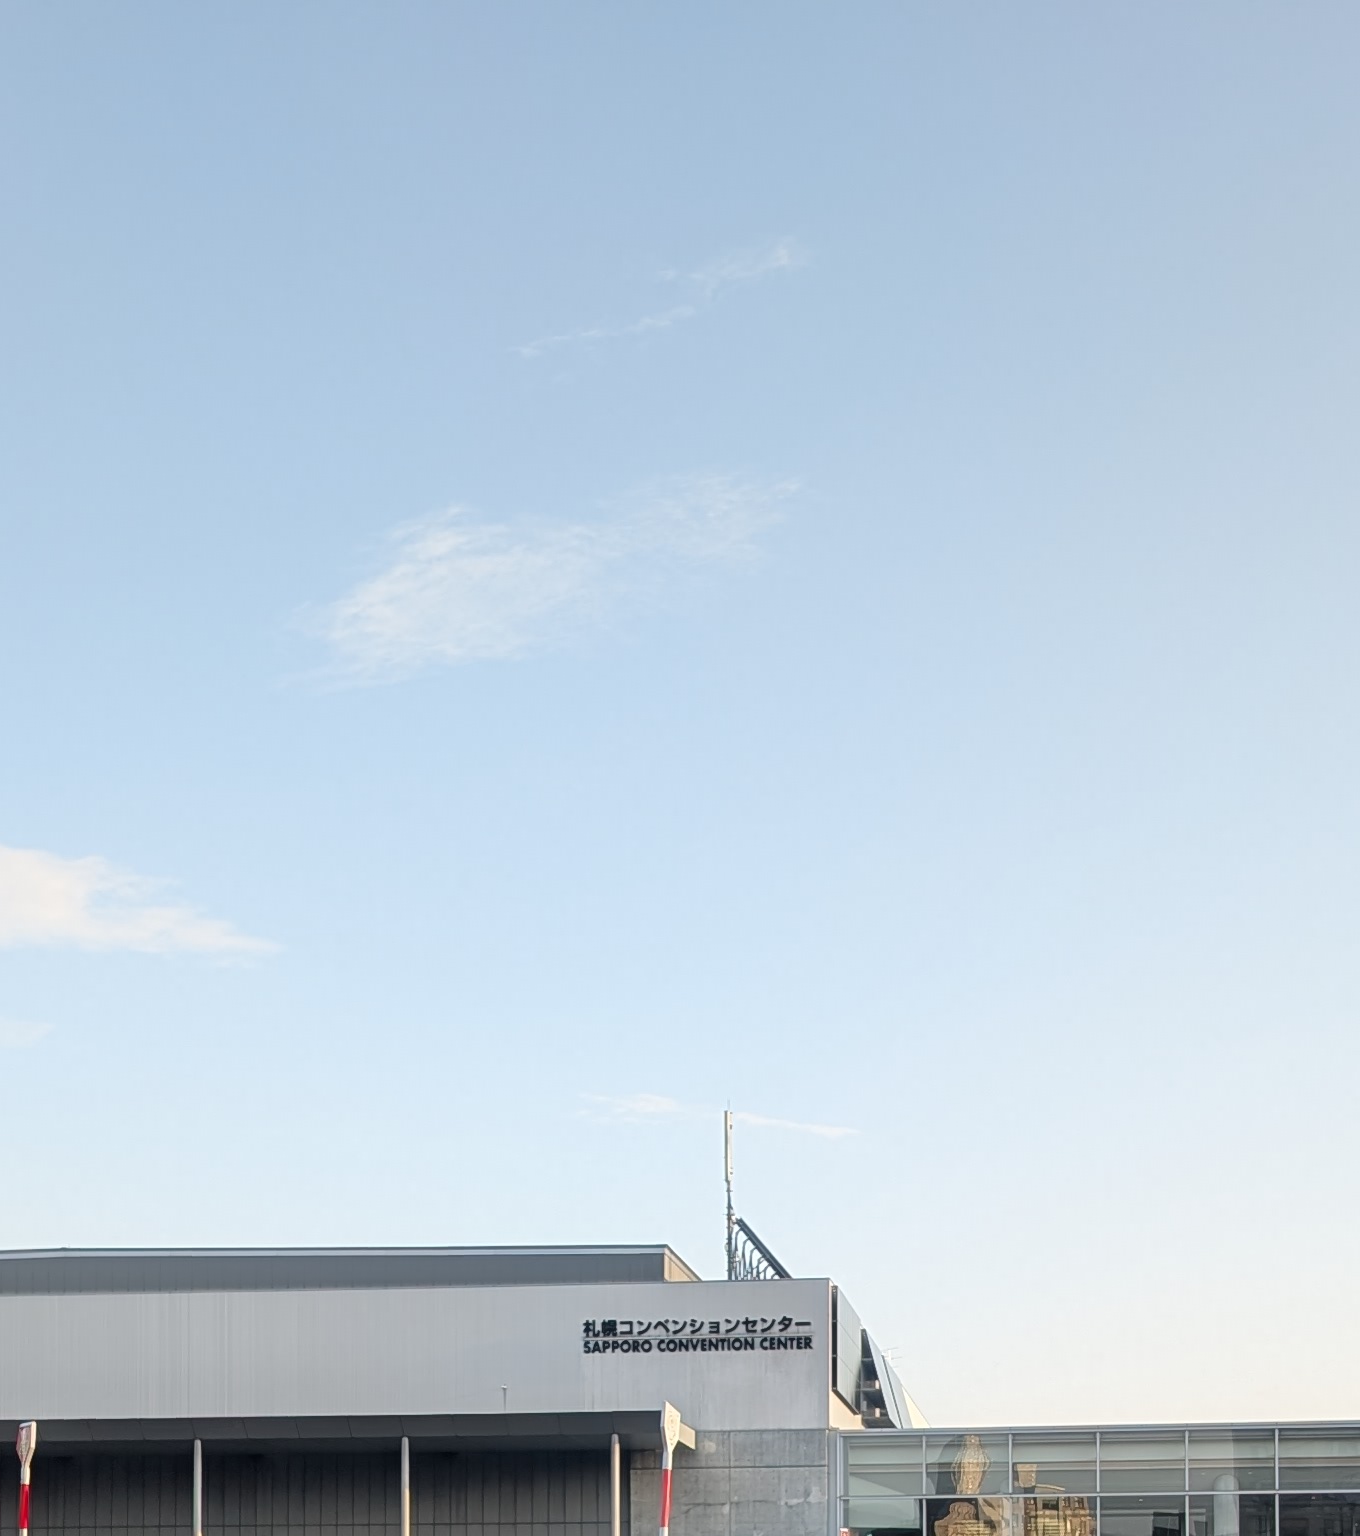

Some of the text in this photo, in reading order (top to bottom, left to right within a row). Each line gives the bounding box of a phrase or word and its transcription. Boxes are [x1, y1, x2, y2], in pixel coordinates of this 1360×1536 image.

[583, 1316, 811, 1337] 札幌コンベンションセンター
[583, 1337, 813, 1353] SAPPORO CONVENTION CENTER
